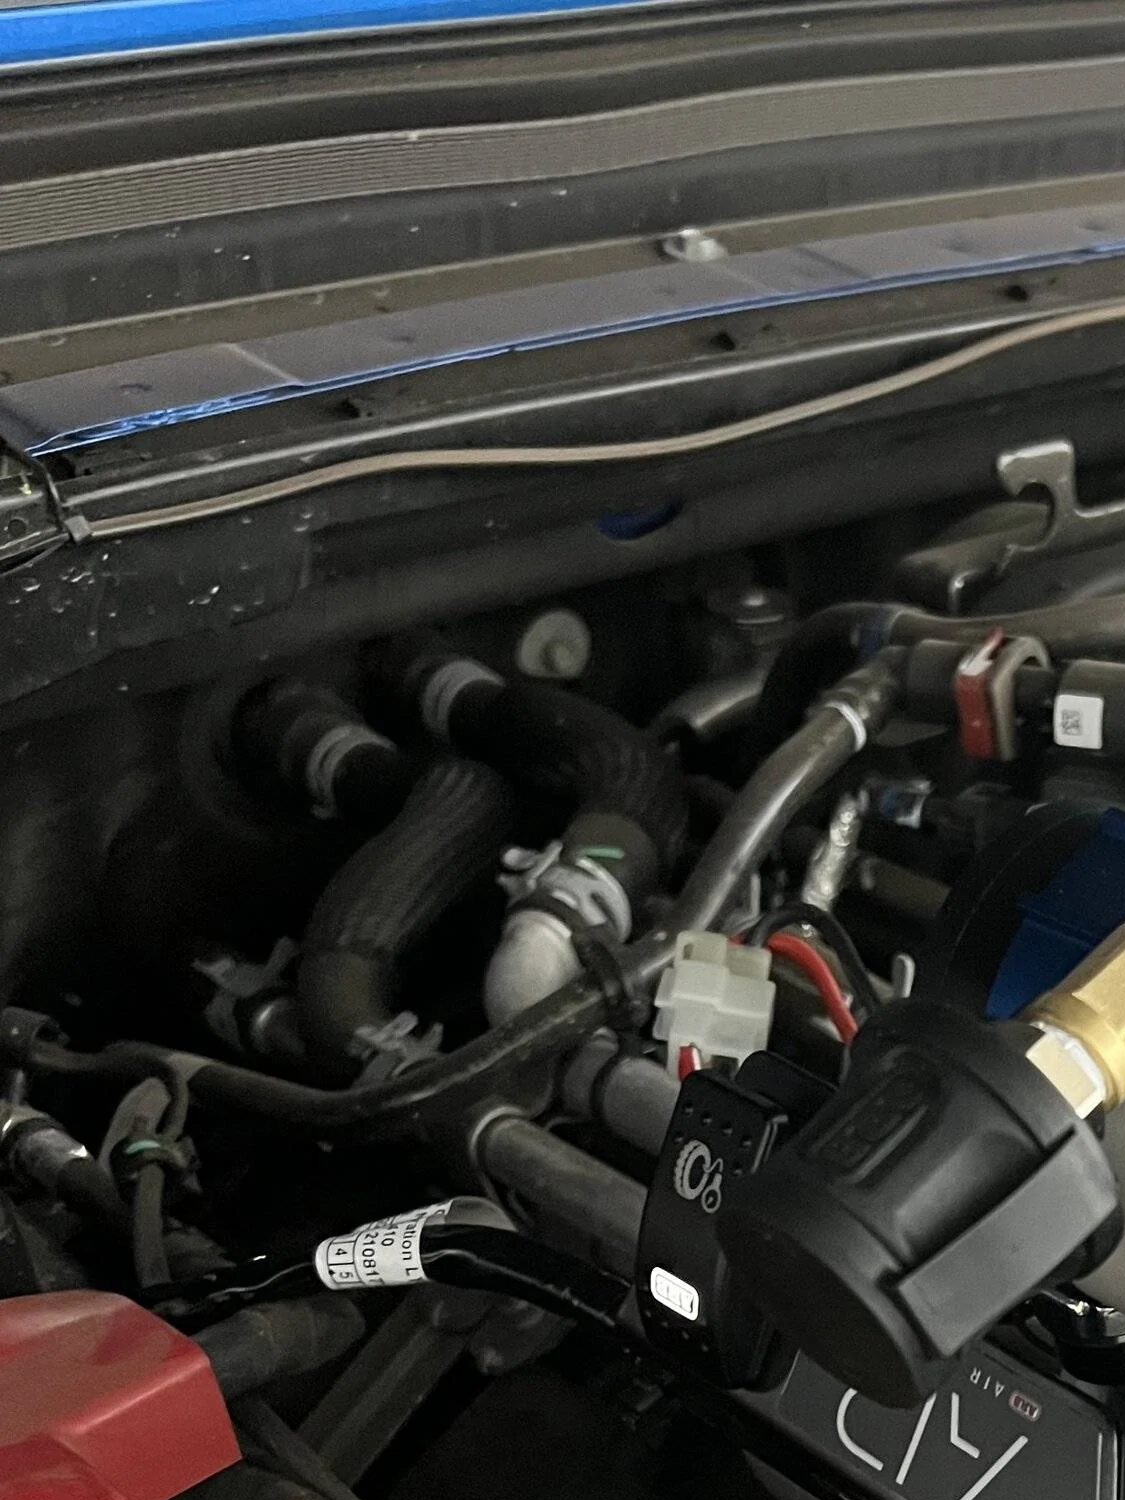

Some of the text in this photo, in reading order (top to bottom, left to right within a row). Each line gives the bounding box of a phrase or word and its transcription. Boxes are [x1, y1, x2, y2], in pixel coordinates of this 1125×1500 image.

[335, 1247, 348, 1256] 4
[339, 1271, 355, 1280] 5
[969, 1367, 1005, 1398] AIR
